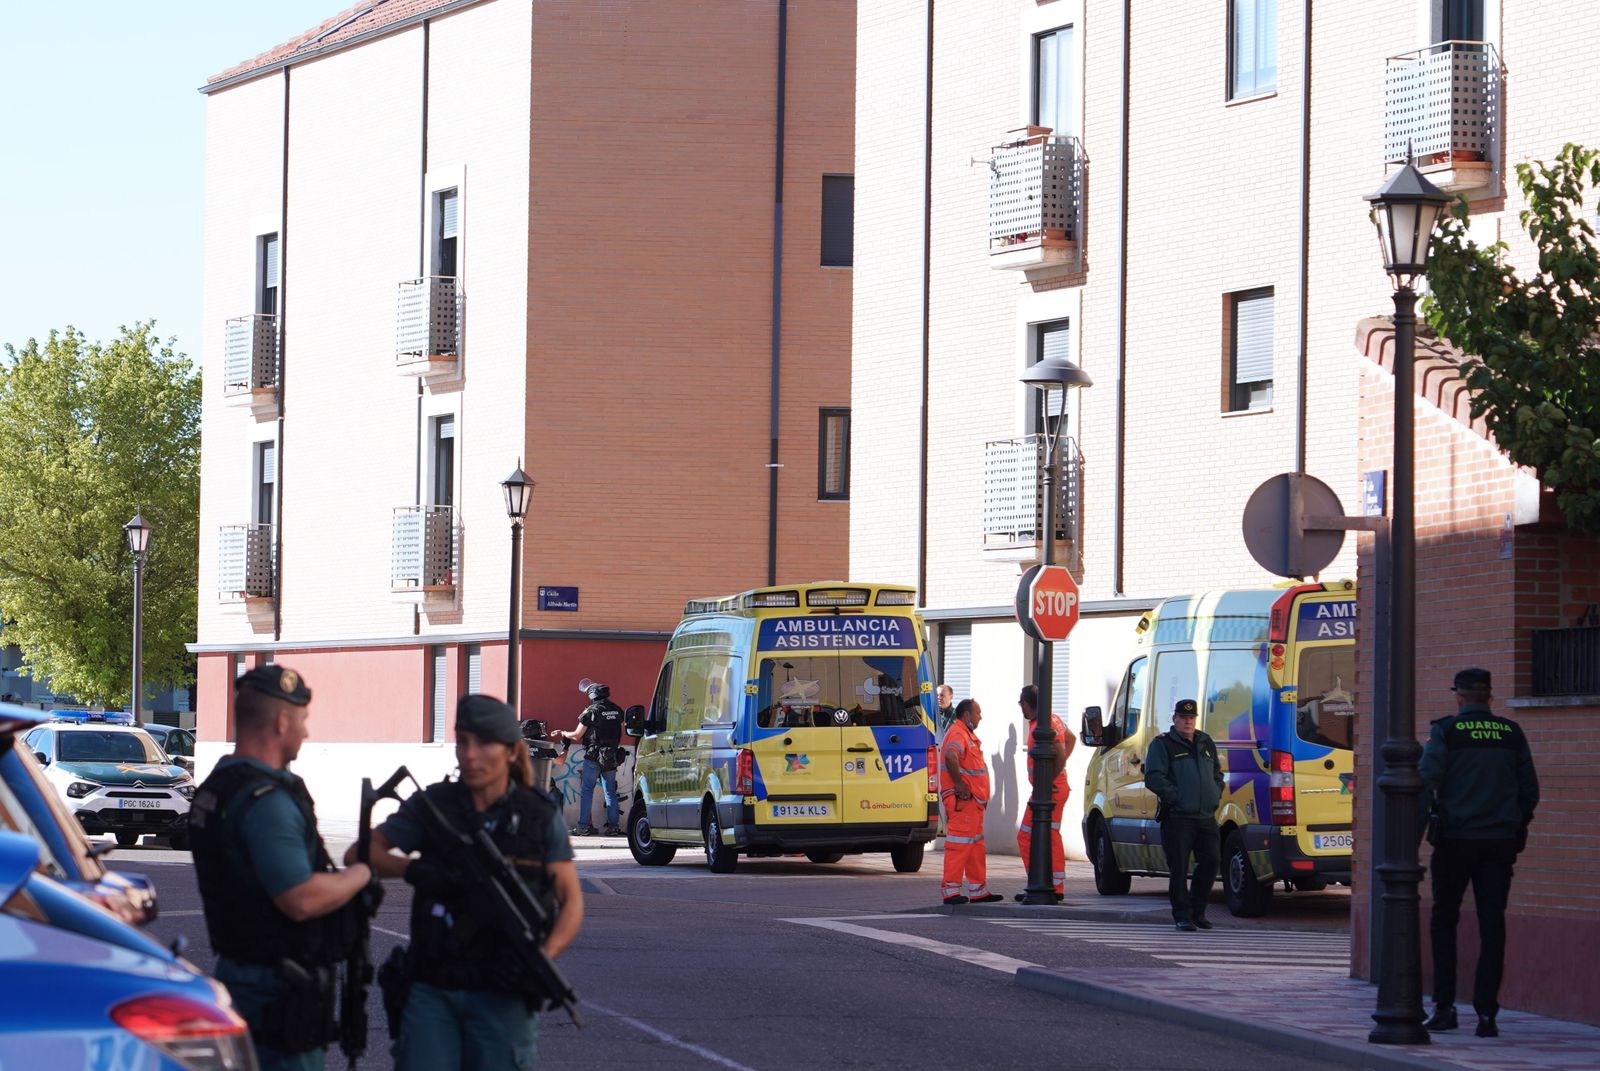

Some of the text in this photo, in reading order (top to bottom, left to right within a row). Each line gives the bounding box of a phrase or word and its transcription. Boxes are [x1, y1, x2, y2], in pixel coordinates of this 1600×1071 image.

[1035, 590, 1077, 617] STOP
[774, 619, 900, 632] AMBULANCIA
[775, 634, 901, 648] ASISTENCIAL
[1455, 721, 1513, 732] GUARDIA
[1471, 730, 1502, 739] CIVIL
[885, 754, 913, 773] 112
[780, 805, 827, 816] 9134 KLS
